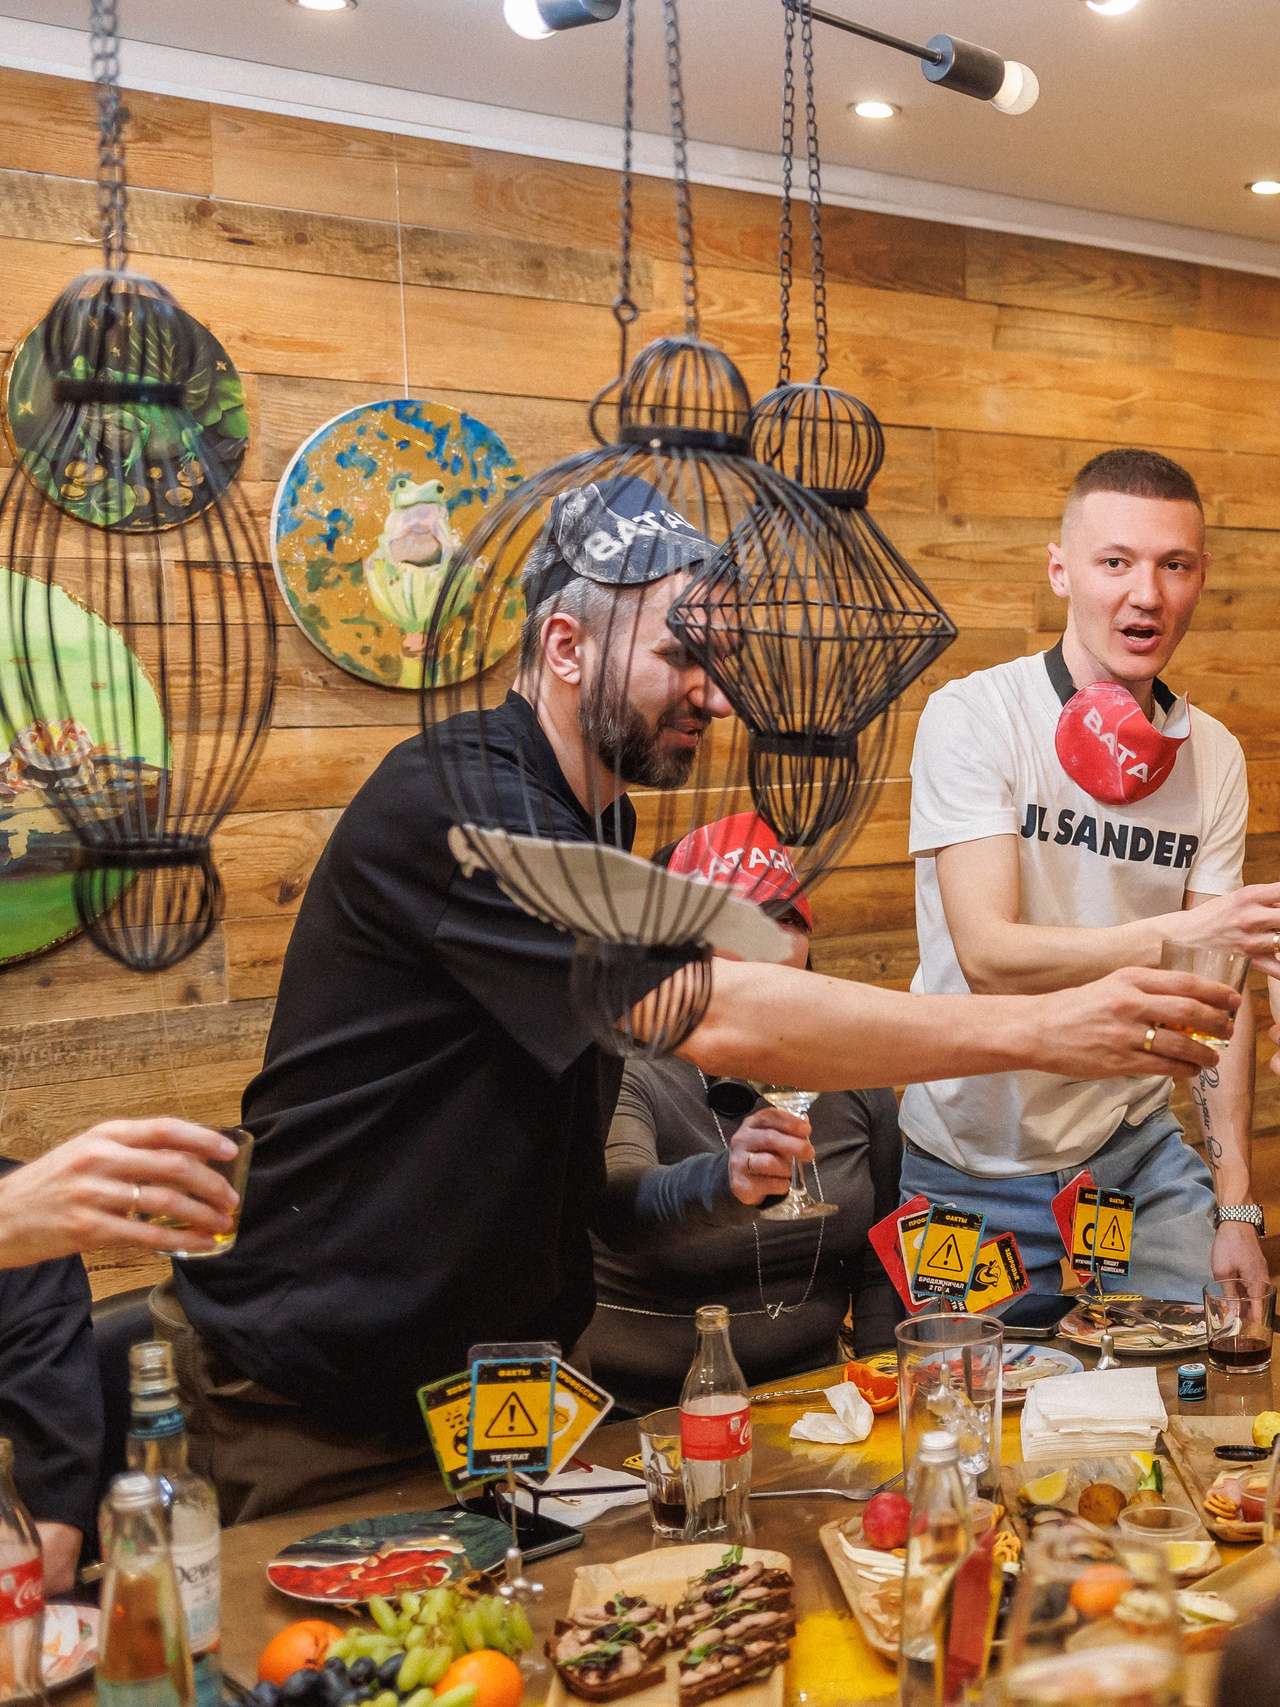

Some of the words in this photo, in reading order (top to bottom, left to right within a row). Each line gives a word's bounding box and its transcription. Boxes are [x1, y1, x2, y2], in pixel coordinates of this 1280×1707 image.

[1053, 809, 1199, 869] SANDER
[945, 1214, 968, 1224] ФАКТЫ
[1004, 1247, 1020, 1281] ЗДОРОВЬЕ
[918, 1276, 965, 1289] БРОДЯЖНИЧАЛ
[556, 1369, 600, 1403] ПРОФЕССИЯ
